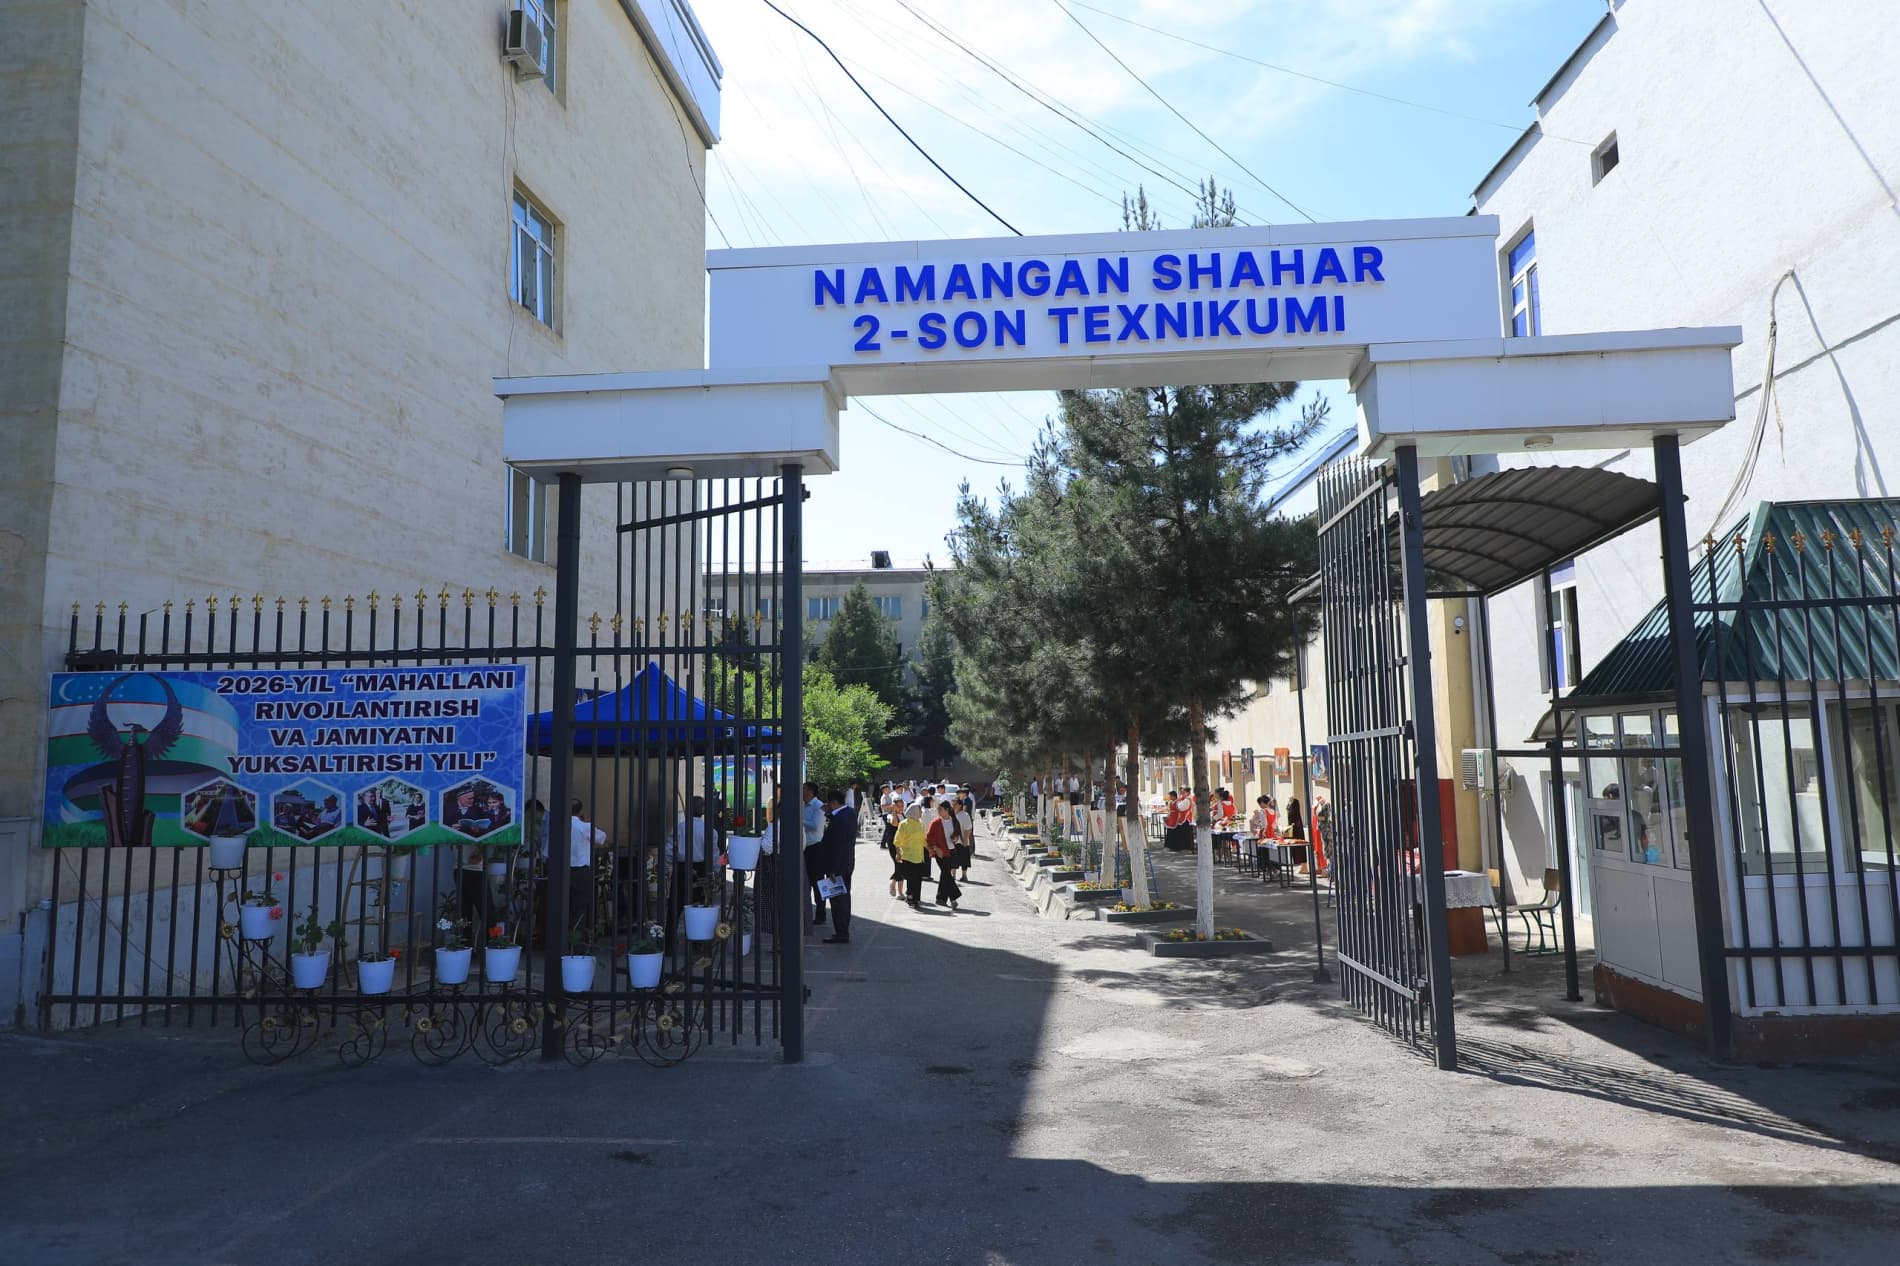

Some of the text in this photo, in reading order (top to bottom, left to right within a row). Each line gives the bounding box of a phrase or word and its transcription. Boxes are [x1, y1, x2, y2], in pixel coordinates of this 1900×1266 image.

[813, 245, 1385, 306] NAMANGAN SHAHAR
[853, 294, 1346, 352] 2-SON TEXNIKUMI
[216, 674, 335, 695] 2026-YIL
[255, 698, 480, 721] RIVOJLANTIRISH
[269, 725, 456, 747] VA JAMIYATNI
[225, 752, 424, 775] YUKSALTIRISH
